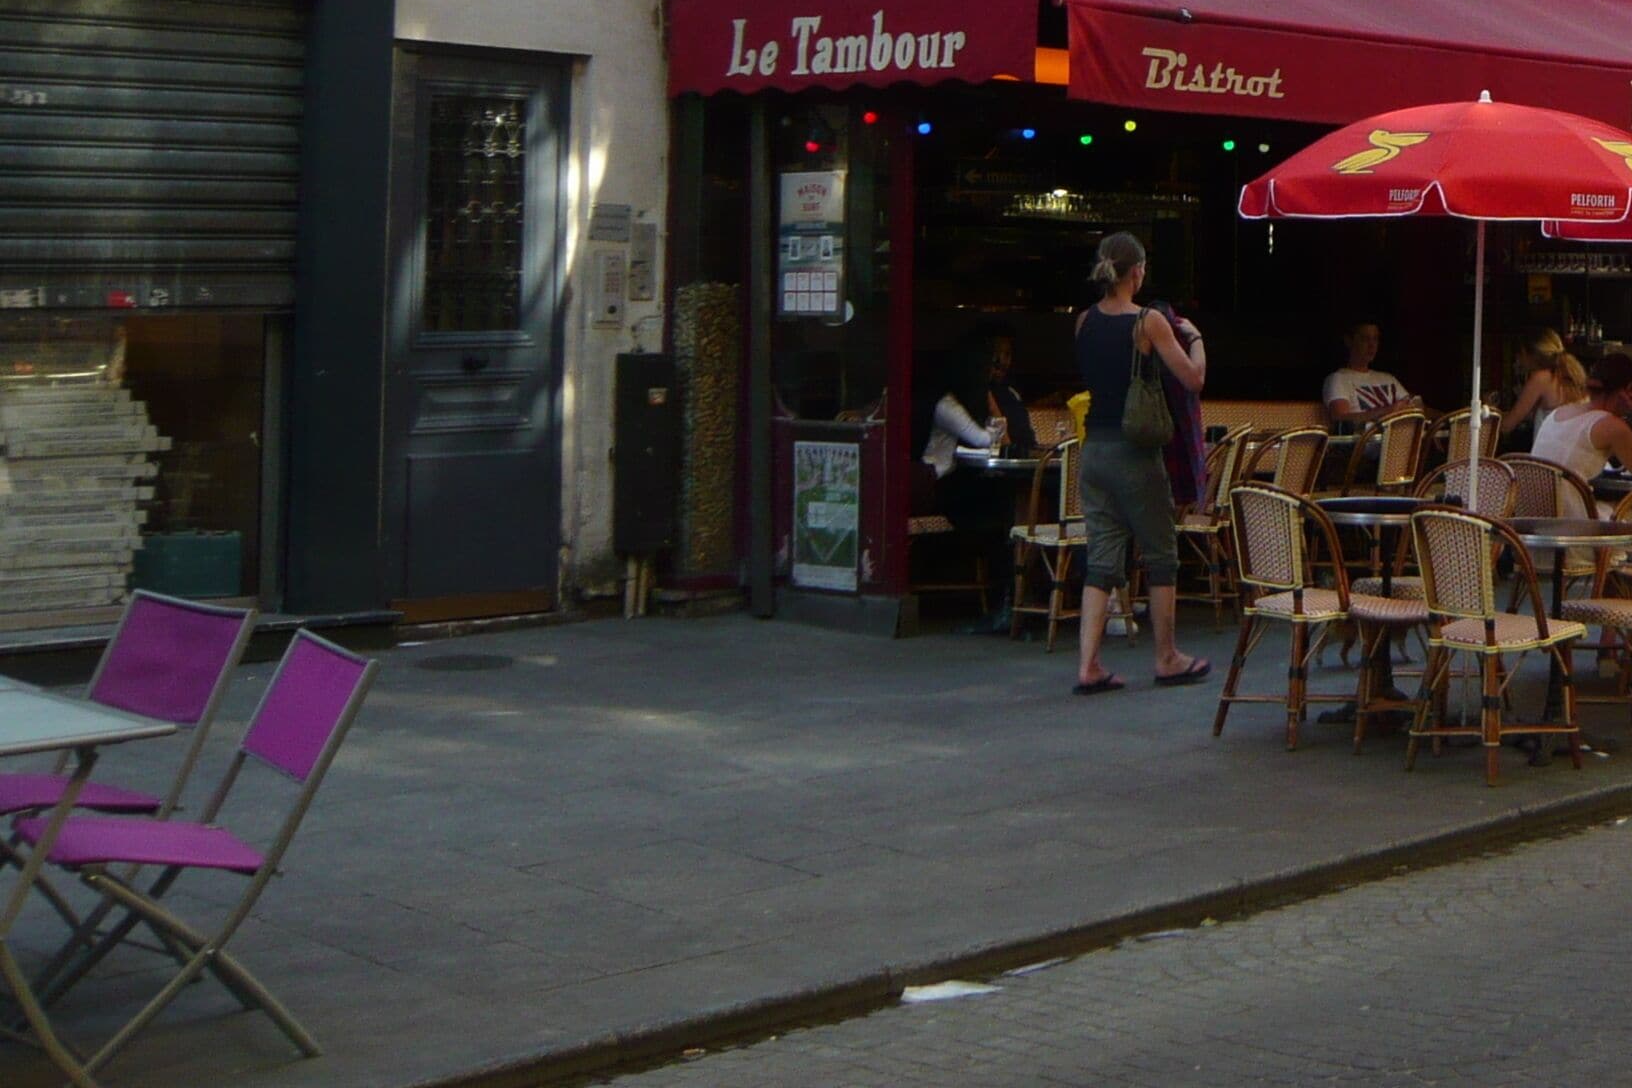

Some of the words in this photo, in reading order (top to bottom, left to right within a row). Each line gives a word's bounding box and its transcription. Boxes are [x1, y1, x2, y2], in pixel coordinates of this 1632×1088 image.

[726, 18, 779, 76] Le
[790, 9, 966, 75] Tambour
[1142, 46, 1285, 99] Bistrot
[1570, 193, 1616, 207] PELFORTH
